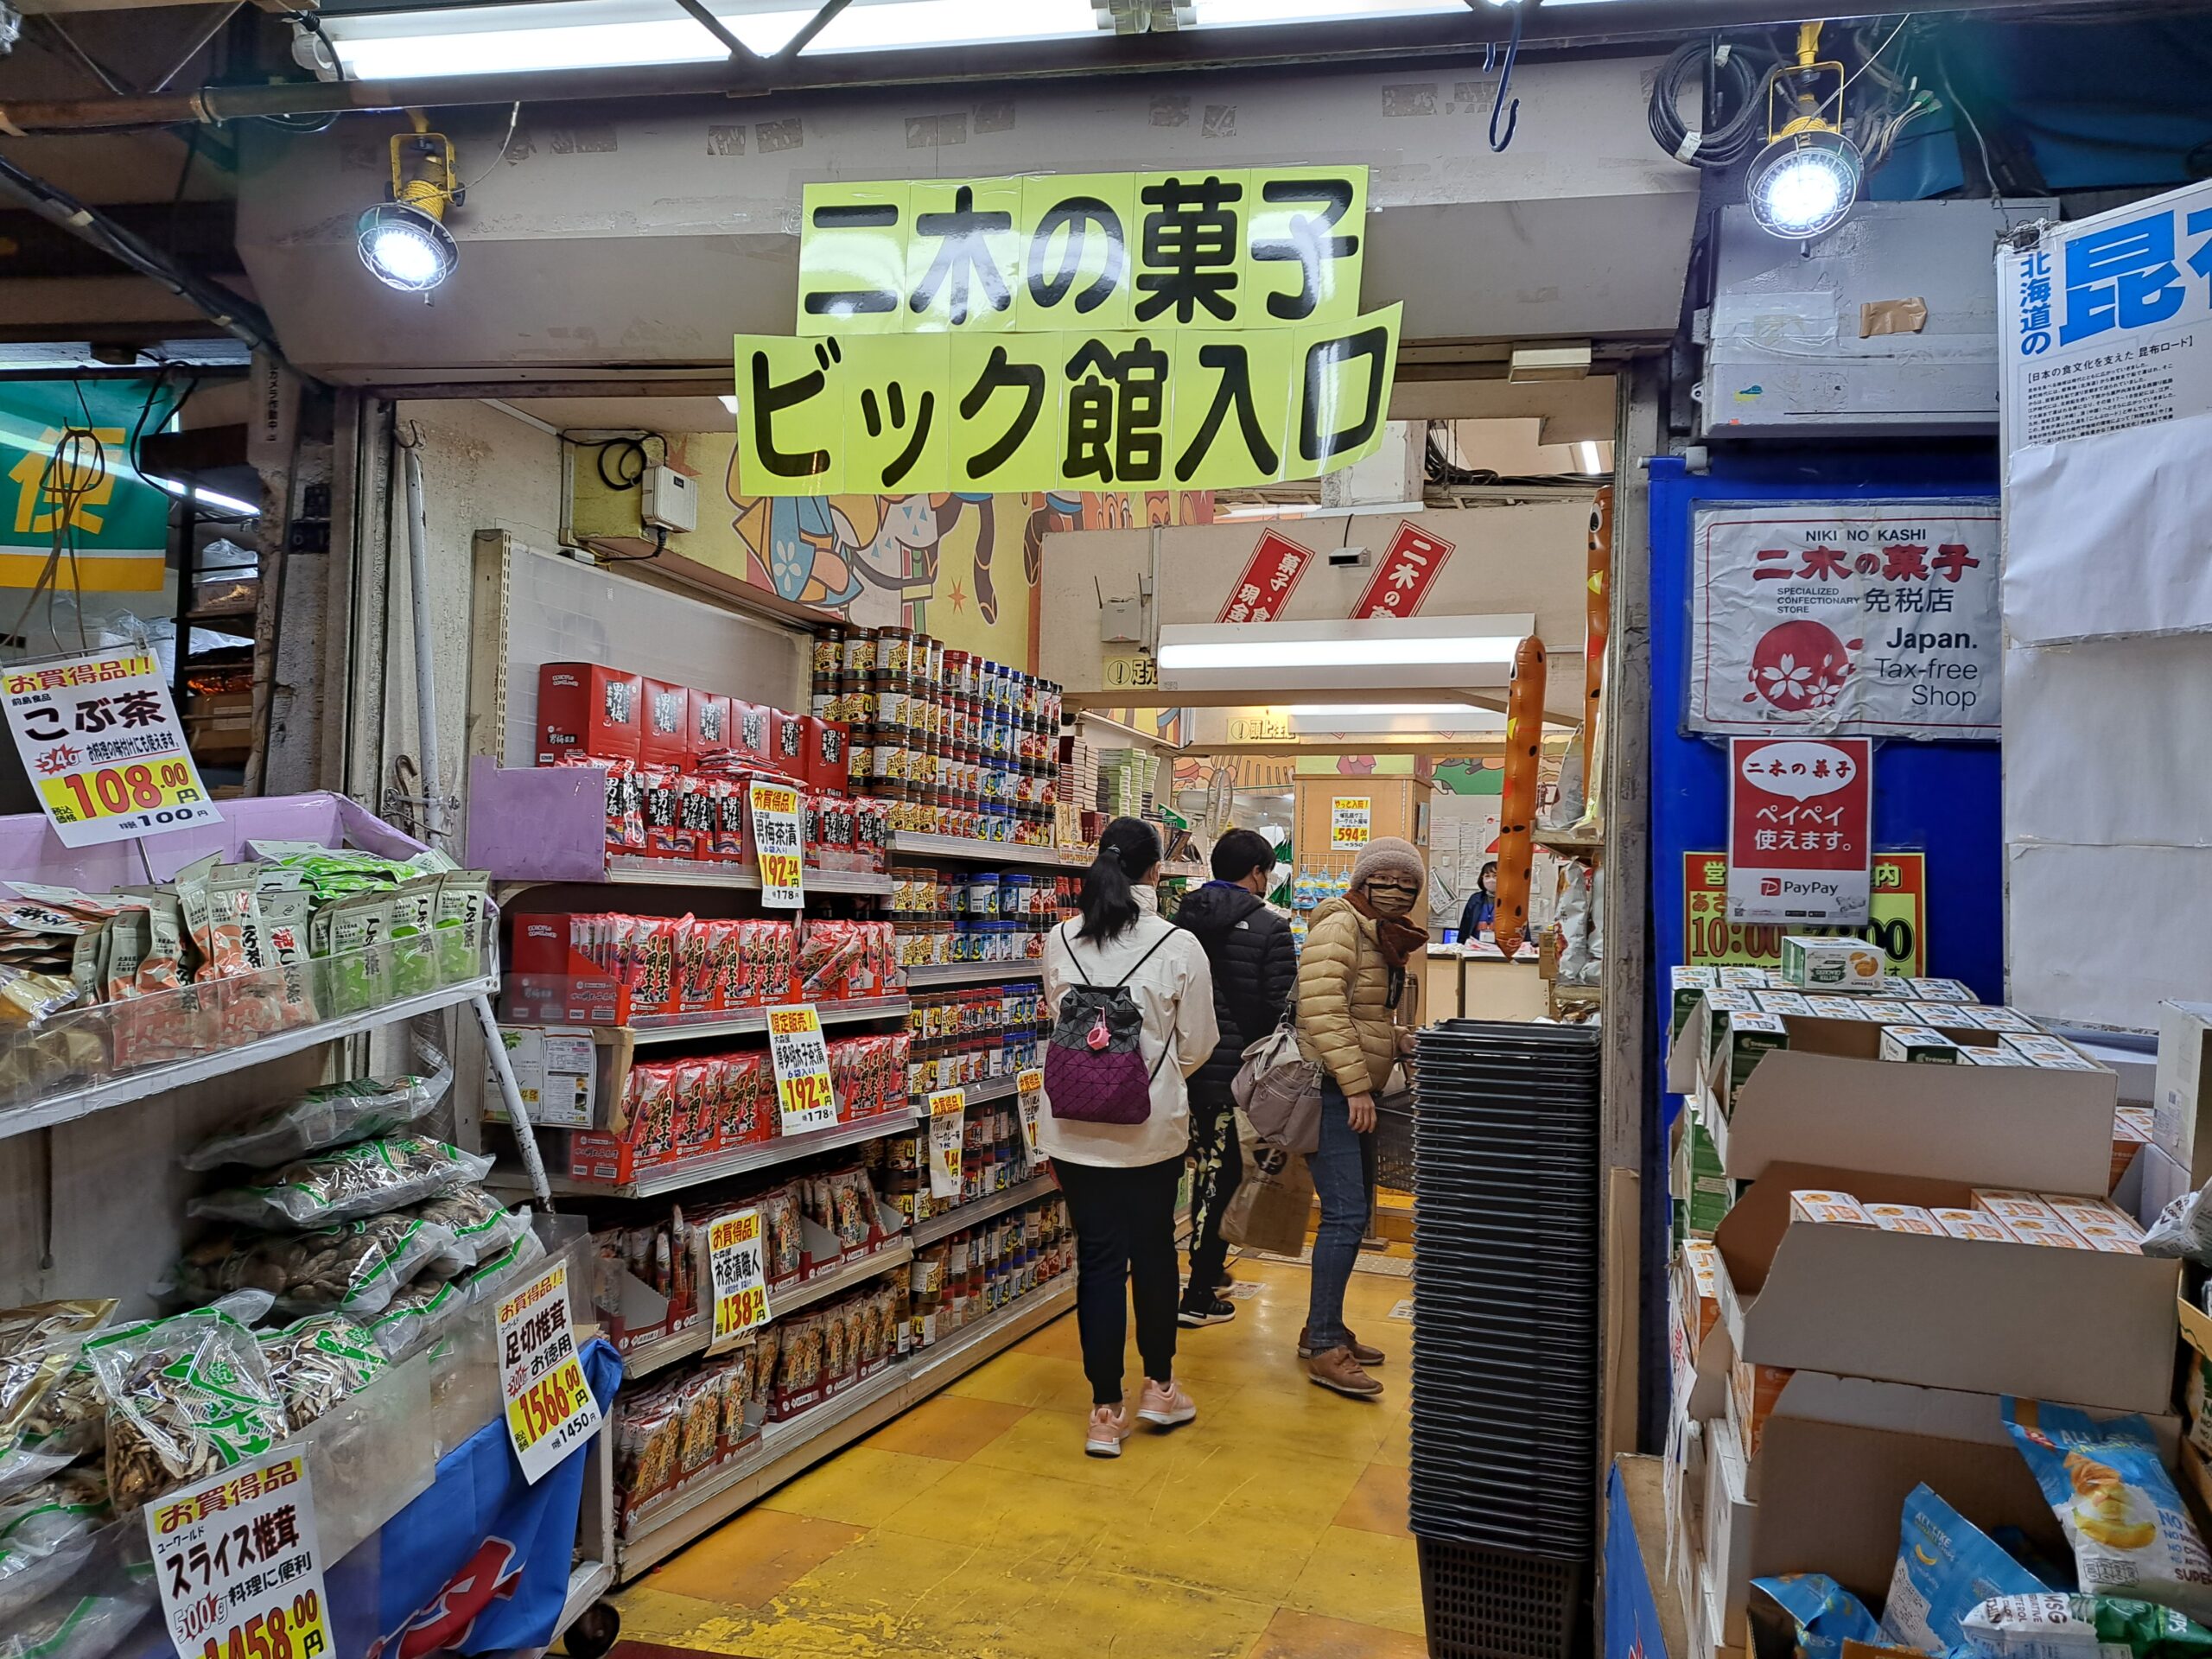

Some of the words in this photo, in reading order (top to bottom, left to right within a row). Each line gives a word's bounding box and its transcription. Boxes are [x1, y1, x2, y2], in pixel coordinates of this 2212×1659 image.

[804, 176, 1358, 325] 二木の菓子
[2019, 251, 2051, 356] 北海道の
[751, 325, 1388, 487] ビック館入口
[9, 427, 125, 536] 便
[1806, 530, 1838, 542] NIKI
[1847, 530, 1869, 542] NO
[1878, 529, 1926, 542] KASHI
[1752, 543, 1980, 582] 二木の菓子
[1777, 588, 1840, 596] SPECIALIZED
[1865, 588, 1953, 613] 免税店
[1887, 628, 1978, 654] Japan.
[9, 657, 150, 694] お買得品!!
[1874, 657, 1978, 681] Tax-free
[1911, 684, 1977, 709] Shop
[23, 690, 166, 741] こぶ茶
[40, 750, 80, 771] 54g
[86, 732, 180, 762] お料理の味付けにも使えます。
[1747, 760, 1852, 779] 二木の菓子
[64, 763, 188, 818] 108.00
[754, 790, 797, 812] お買得品!
[137, 808, 194, 827] 100
[1755, 805, 1845, 827] ペイペイ
[756, 819, 798, 847] 男梅茶漬
[1754, 829, 1852, 851] 使えます。
[777, 890, 794, 899] 178
[1784, 880, 1839, 897] PayPay
[771, 1012, 814, 1033] 限定販売!
[808, 1109, 830, 1122] 178
[713, 1216, 760, 1249] お買得品!
[715, 1249, 760, 1287] お茶漬職人
[500, 1268, 563, 1323] お買得品!!
[505, 1298, 567, 1370] 足切椎茸
[531, 1332, 573, 1376] お徳用
[575, 1389, 589, 1408] 円
[559, 1412, 589, 1444] 1450
[161, 1460, 298, 1535] お買得品
[2159, 1510, 2183, 1531] NO
[157, 1526, 205, 1554] ユーワールド
[2164, 1530, 2178, 1541] NO
[2167, 1543, 2182, 1553] NO
[166, 1503, 300, 1600] スライス椎茸
[174, 1596, 228, 1644] 500g
[229, 1552, 312, 1607] 料理に便利
[303, 1629, 324, 1658] 円
